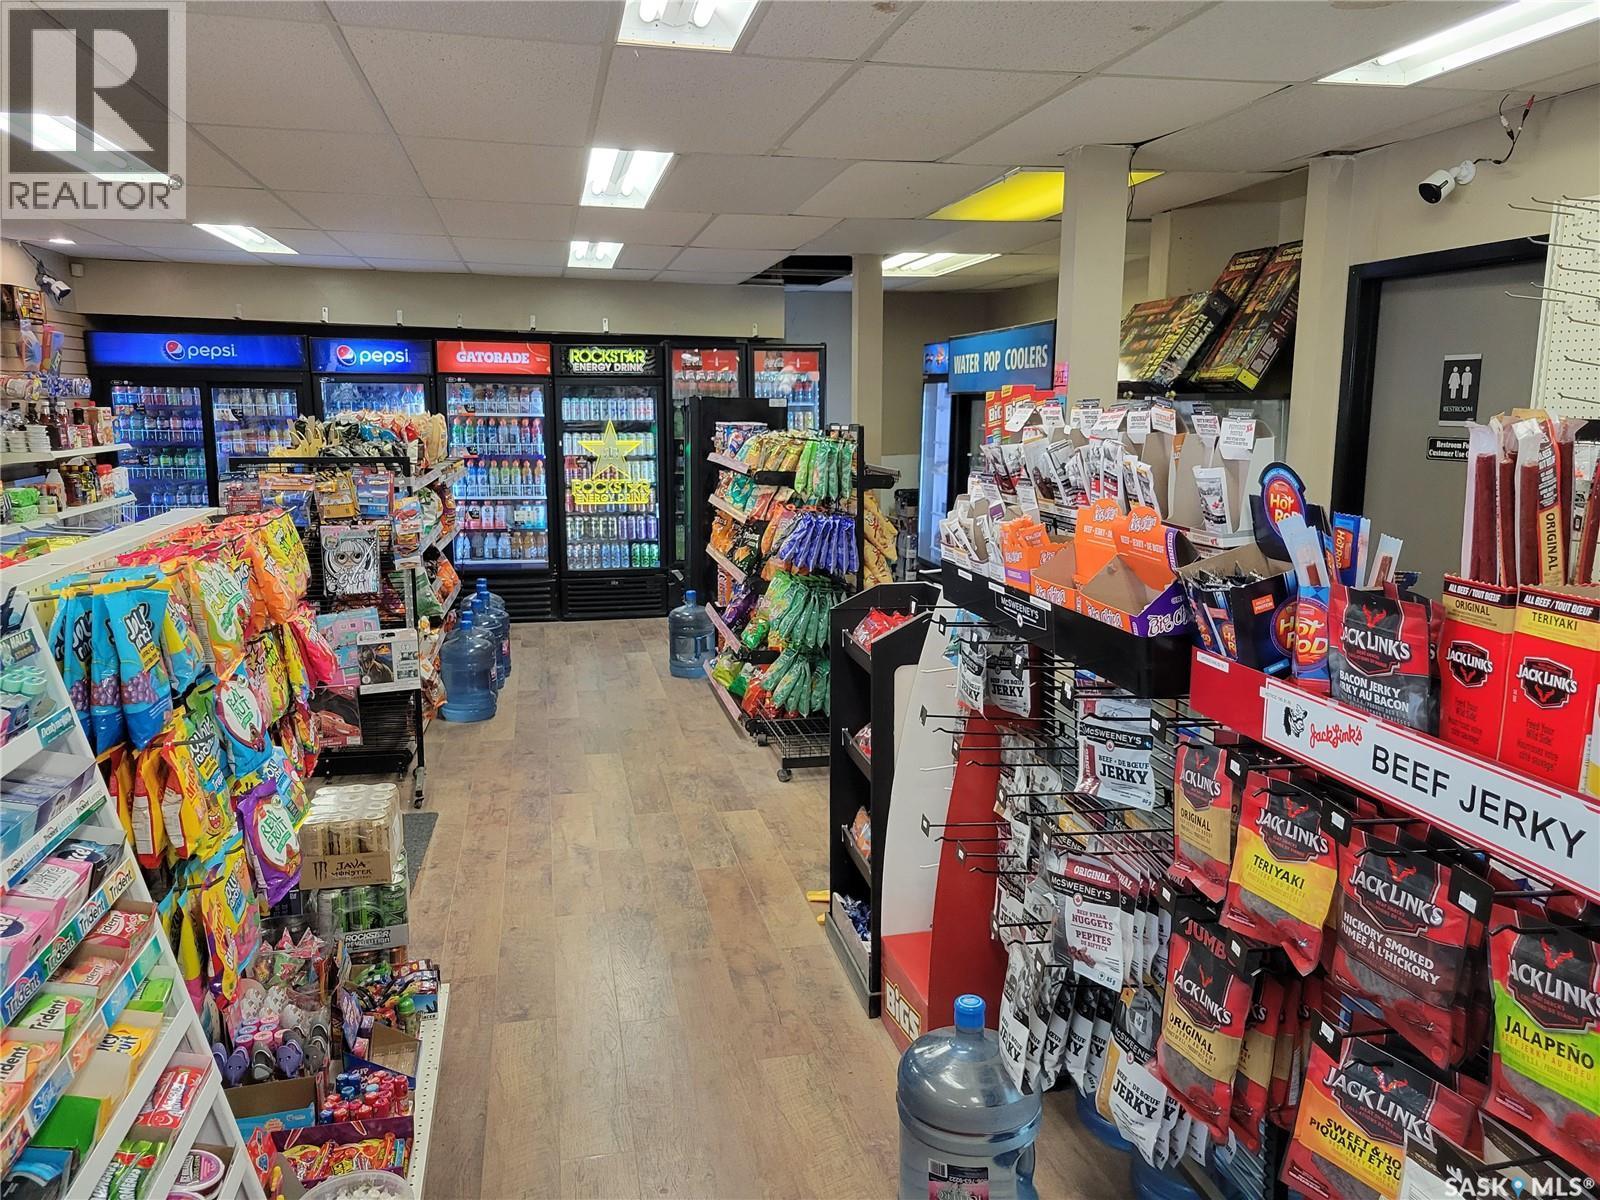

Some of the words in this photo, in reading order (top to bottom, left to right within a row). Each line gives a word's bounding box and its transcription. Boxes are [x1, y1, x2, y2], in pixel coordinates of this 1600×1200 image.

[1171, 314, 1209, 359] THUNDER
[187, 342, 236, 359] pepsi
[358, 348, 410, 366] pepsi
[456, 351, 529, 365] GATORADE
[570, 348, 646, 363] ROCKSTAR
[953, 352, 980, 375] WATER
[983, 350, 1001, 372] POP
[1004, 344, 1048, 370] COOLERS
[573, 362, 612, 373] ENERGY
[613, 362, 644, 373] DRINK
[1442, 405, 1473, 413] RESTROOM
[1428, 449, 1454, 458] Customer
[1454, 450, 1465, 459] Use
[1436, 440, 1463, 449] Restroom
[571, 480, 651, 494] ROCKSTAR
[1545, 512, 1559, 571] ORIGINAL
[1448, 583, 1458, 593] ALL
[1458, 585, 1470, 596] BEEF
[1472, 588, 1485, 599] TOUT
[1523, 594, 1535, 604] ALL
[1534, 596, 1550, 608] BEEF
[1554, 600, 1571, 613] TOUT
[1000, 595, 1040, 620] McSWEENEY'S
[1455, 600, 1490, 616] ORIGINAL
[1532, 611, 1578, 632] TERIYAKI
[10, 630, 31, 649] HALLS
[1367, 630, 1411, 661] LINK'S
[1446, 647, 1468, 667] JACK
[1467, 654, 1493, 674] LINK'S
[991, 684, 1025, 698] JERKY
[1340, 670, 1368, 688] BACON
[1369, 680, 1401, 699] JERKY
[1516, 664, 1544, 686] JACK
[1544, 671, 1578, 695] LINK'S
[1358, 689, 1372, 702] AU
[1373, 694, 1409, 713] BACON
[1084, 726, 1142, 745] McSWEENEY'S
[1310, 722, 1334, 748] Jack
[1332, 723, 1363, 749] Link's
[1098, 754, 1113, 764] BEEF
[1117, 759, 1127, 768] DE
[1099, 763, 1149, 785] JERKY
[1196, 773, 1221, 797] LINK'S
[1371, 744, 1450, 798] BEEF
[1458, 784, 1587, 859] JERKY
[1180, 807, 1211, 833] ORIGINAL
[1255, 808, 1286, 837] JACK
[1285, 822, 1329, 854] LINK'S
[331, 866, 373, 878] MONSTER
[336, 858, 367, 870] JAVA
[1073, 865, 1111, 884] ORIGINAL
[1253, 854, 1306, 890] TERIYAKI
[110, 869, 133, 900] Trident
[1050, 876, 1112, 901] McSWEENEY'S
[1349, 864, 1391, 903] JACK
[1388, 884, 1444, 926] LINK'S
[79, 901, 106, 932] Trident
[1071, 914, 1114, 931] NUGGETS
[345, 931, 390, 942] ROCKSTAR
[1185, 919, 1230, 961] JUMB
[1343, 911, 1384, 941] HICKORY
[1384, 937, 1435, 970] SMOKED
[45, 932, 77, 972] Trident
[1377, 945, 1441, 986] L'HICKORY
[4, 971, 41, 1016] Trident
[1173, 969, 1201, 1002] JACK
[1199, 989, 1232, 1025] LINK'S
[29, 999, 66, 1030] Trident
[1169, 1012, 1214, 1055] ORIGINAL
[1504, 1014, 1595, 1070] JALAPEÑO
[1113, 1078, 1159, 1120] JERKY
[1323, 1066, 1376, 1111] JACK
[1309, 1116, 1367, 1157] PIQUANT
[1367, 1154, 1384, 1170] ET
[1325, 1117, 1371, 1150] SWEET
[1371, 1144, 1381, 1157] &
[1383, 1152, 1402, 1170] HO
